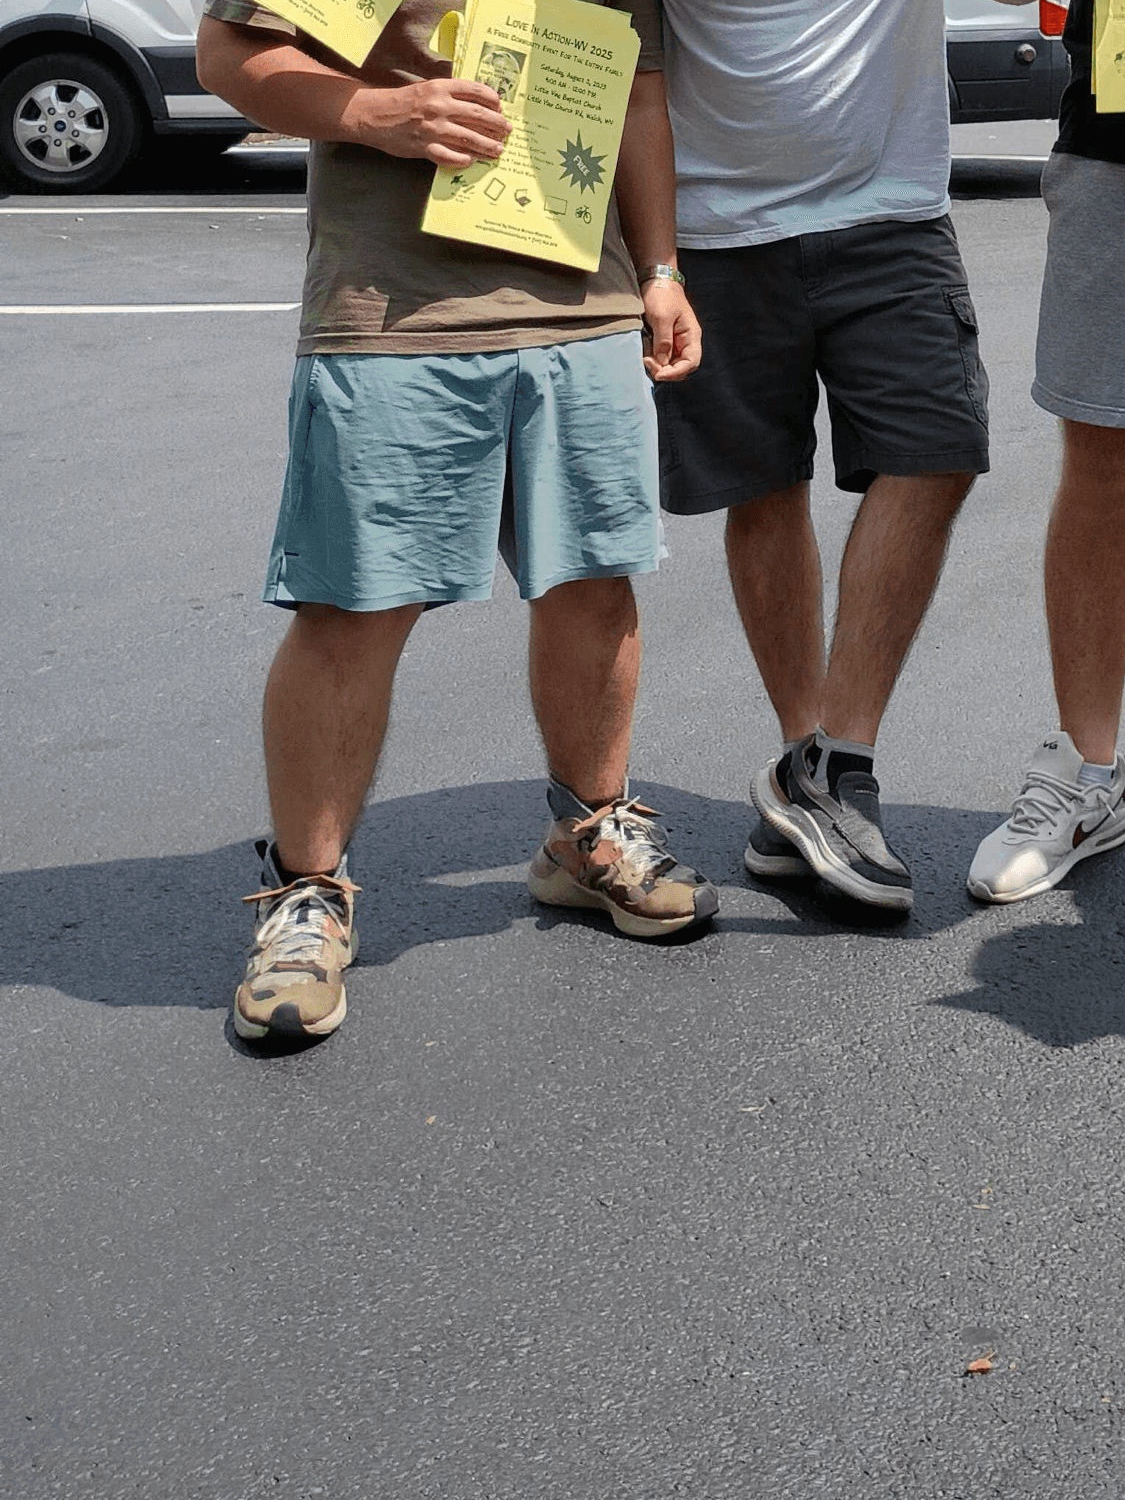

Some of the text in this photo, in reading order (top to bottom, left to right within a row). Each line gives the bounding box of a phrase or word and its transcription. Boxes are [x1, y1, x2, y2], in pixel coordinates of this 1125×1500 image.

[505, 15, 613, 60] LOVE IN ACTION-WV 2025
